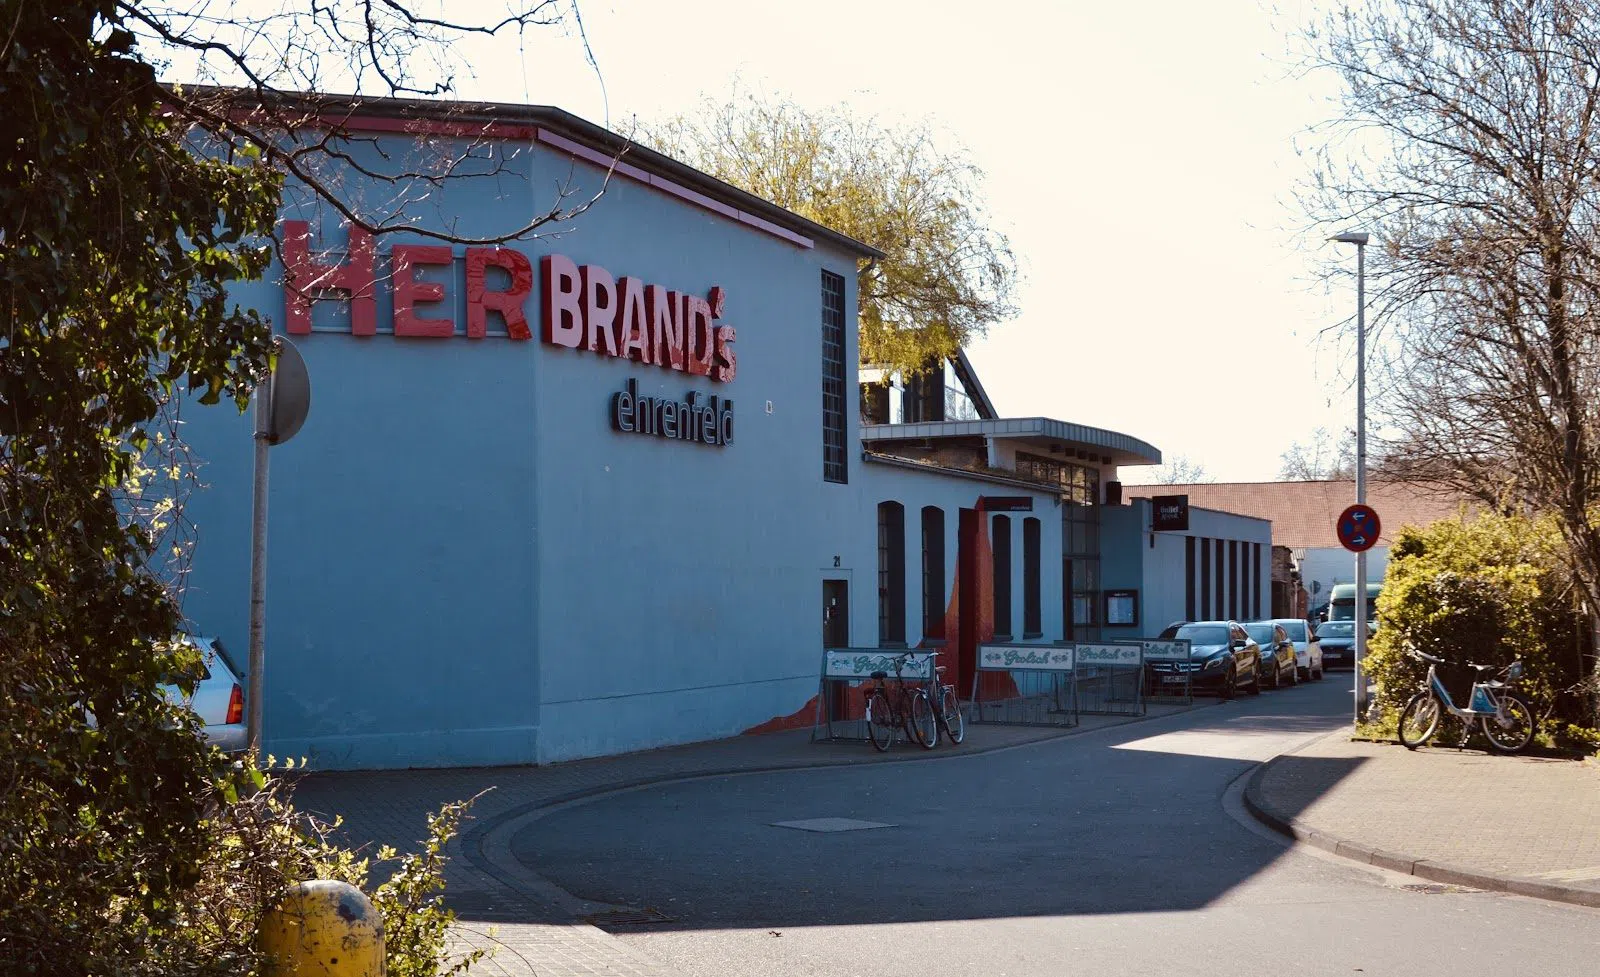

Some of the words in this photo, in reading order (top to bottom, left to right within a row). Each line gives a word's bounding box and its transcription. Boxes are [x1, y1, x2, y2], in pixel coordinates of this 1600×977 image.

[612, 378, 735, 446] ehrenfeld
[833, 555, 841, 567] 21
[1003, 650, 1050, 666] Grolsch
[1078, 647, 1121, 660] Grolsch
